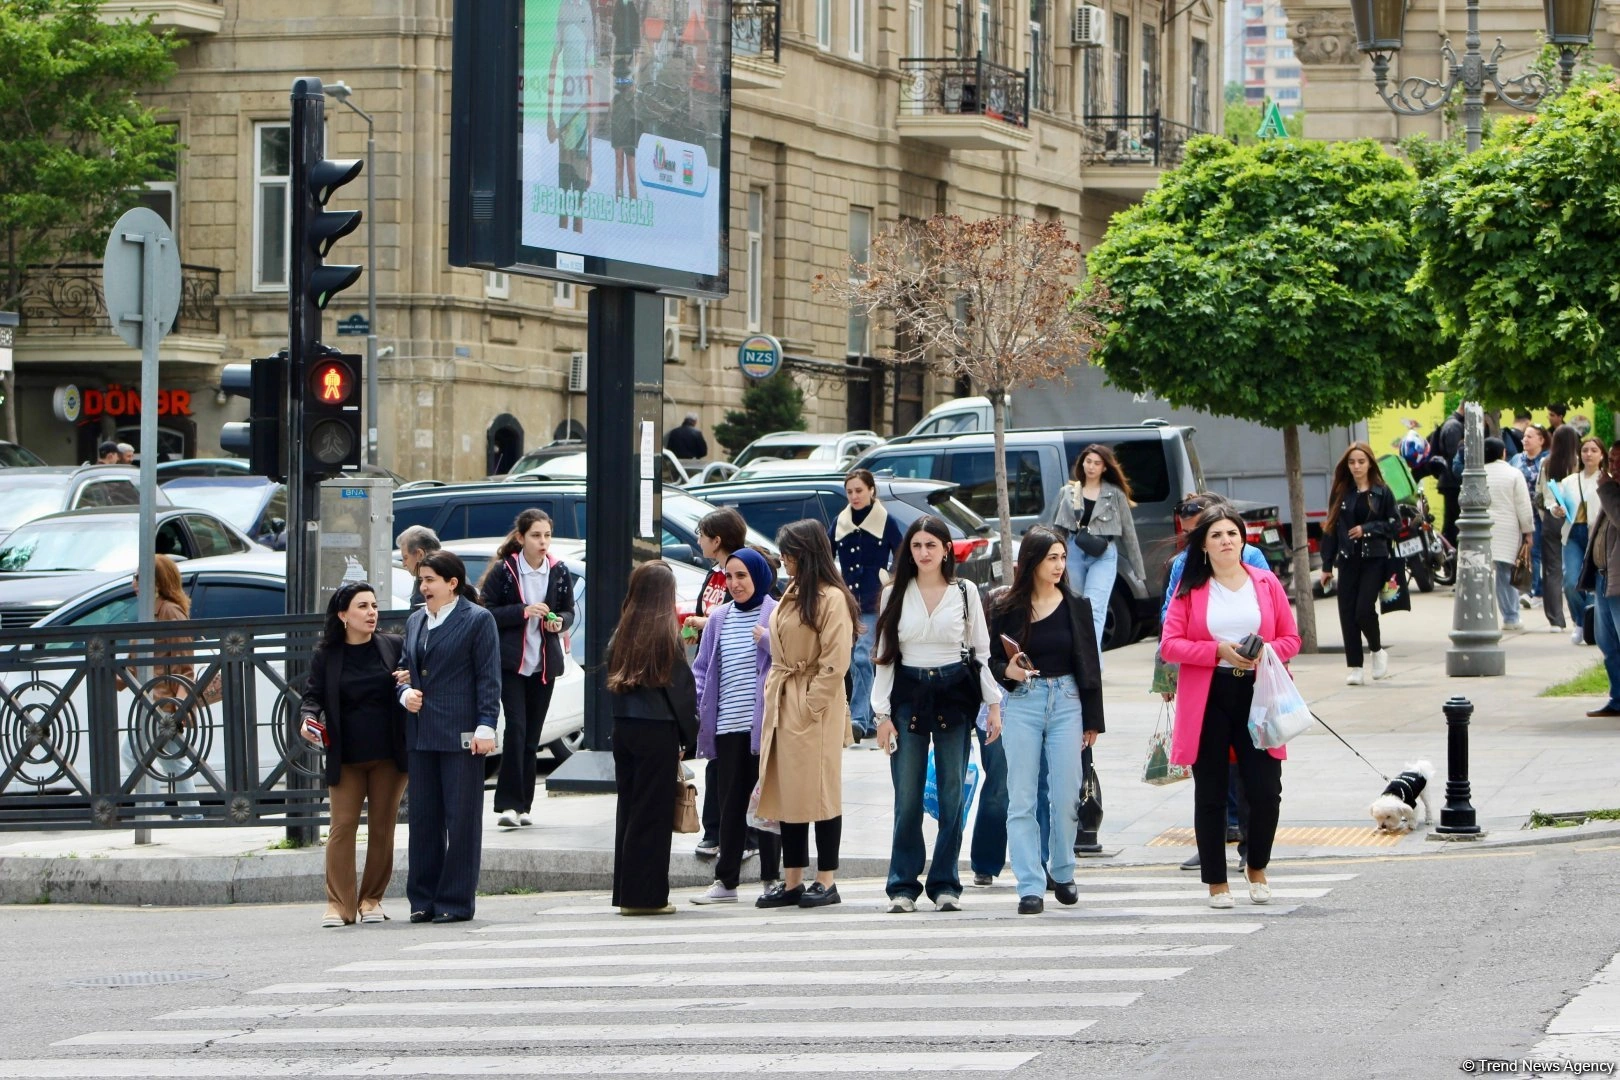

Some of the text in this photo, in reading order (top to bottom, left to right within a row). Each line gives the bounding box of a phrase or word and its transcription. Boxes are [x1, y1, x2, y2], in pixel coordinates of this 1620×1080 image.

[1256, 101, 1290, 138] A
[745, 351, 773, 363] NZS
[345, 488, 364, 496] BNA
